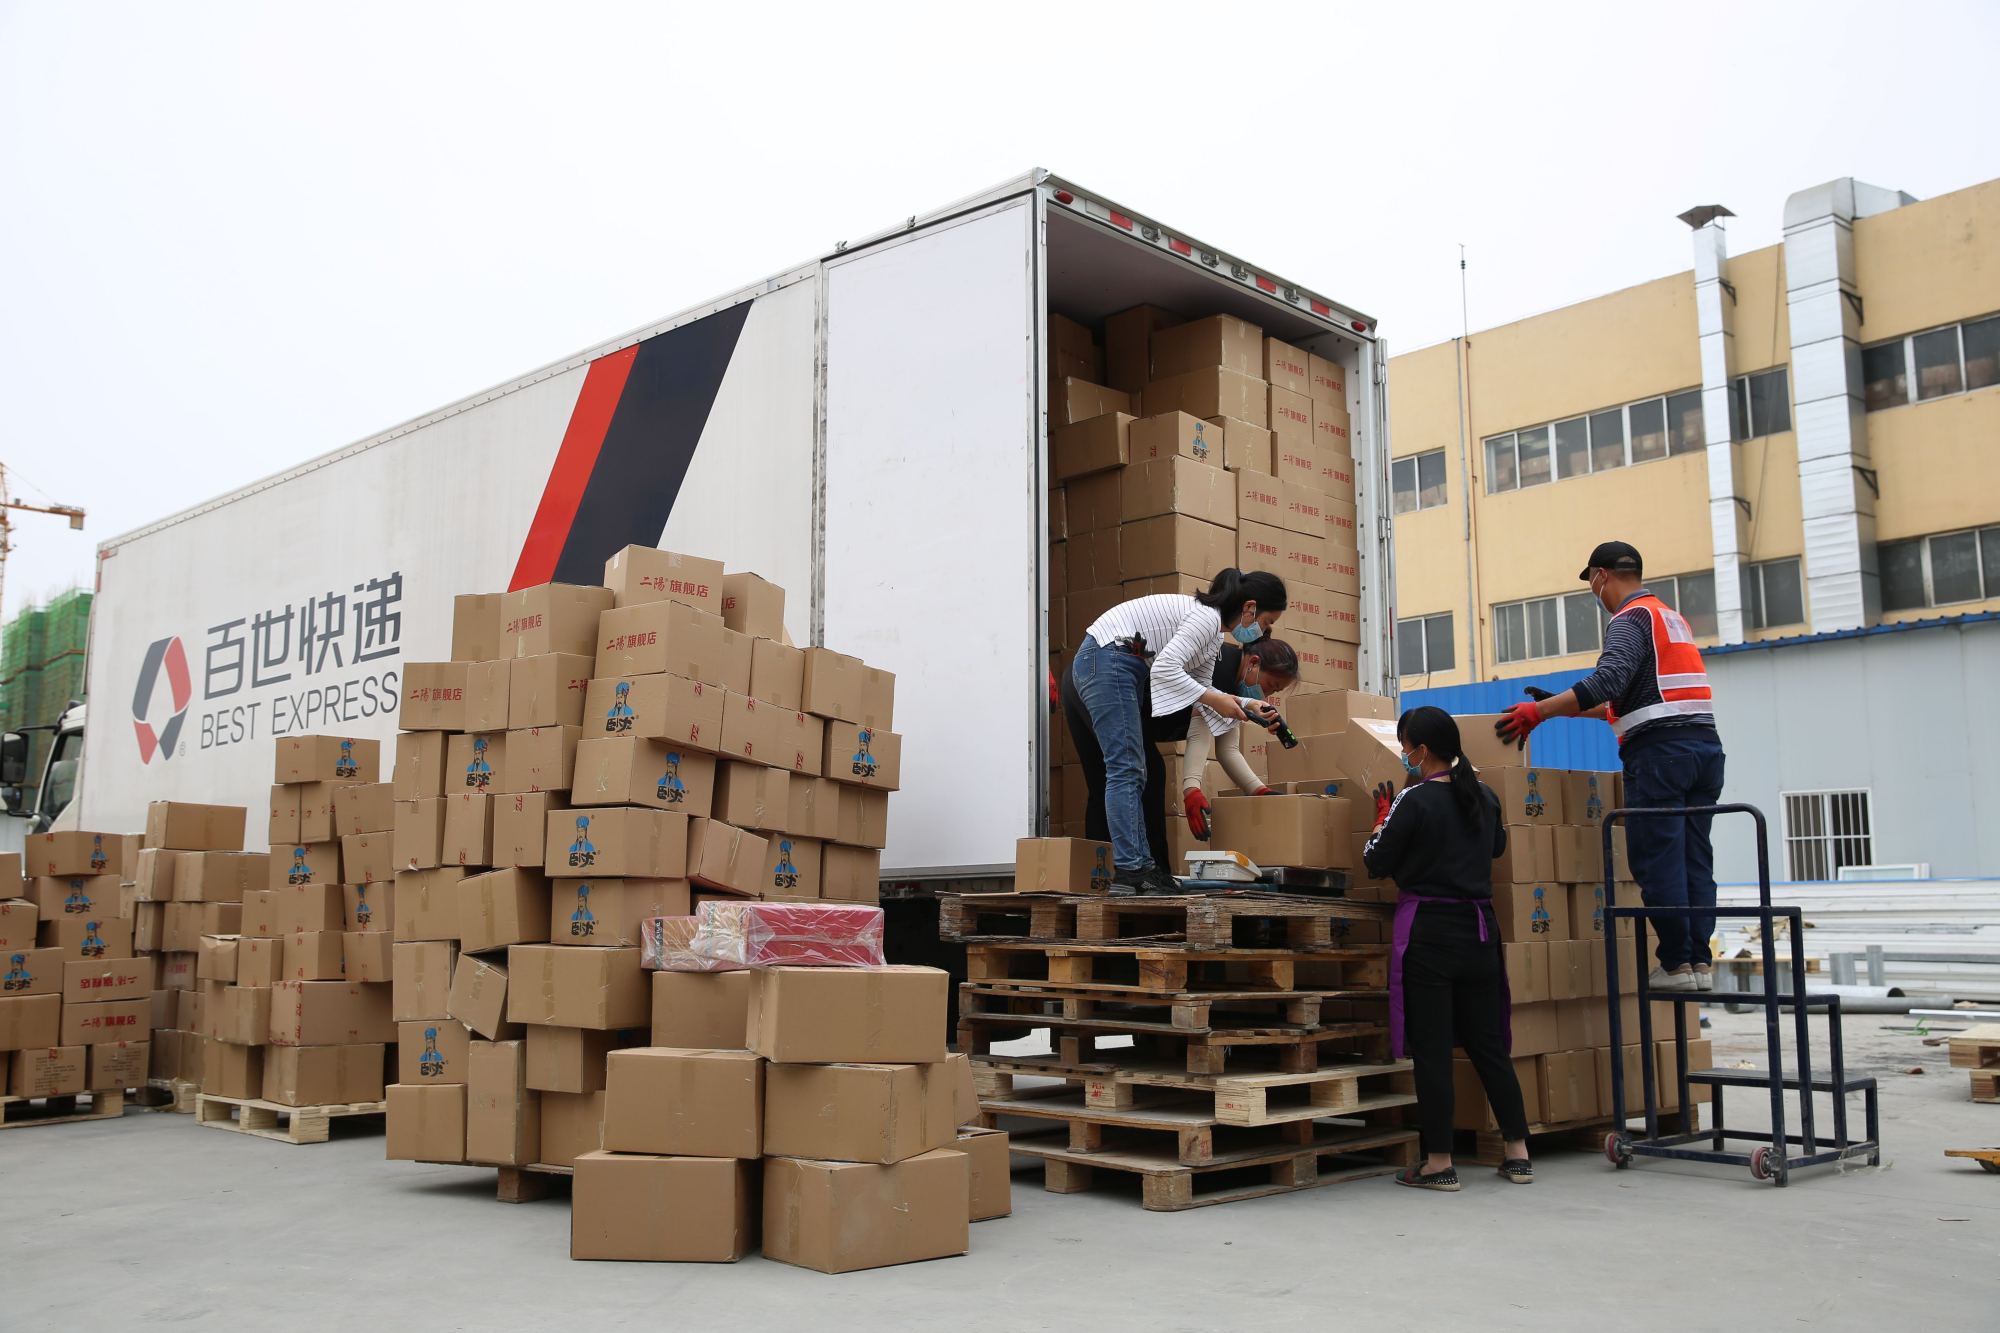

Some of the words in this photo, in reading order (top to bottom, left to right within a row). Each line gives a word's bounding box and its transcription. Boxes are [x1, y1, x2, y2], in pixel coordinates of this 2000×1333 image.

[204, 571, 402, 700] 百世快递
[200, 703, 261, 750] BEST
[272, 671, 398, 735] EXPRESS
